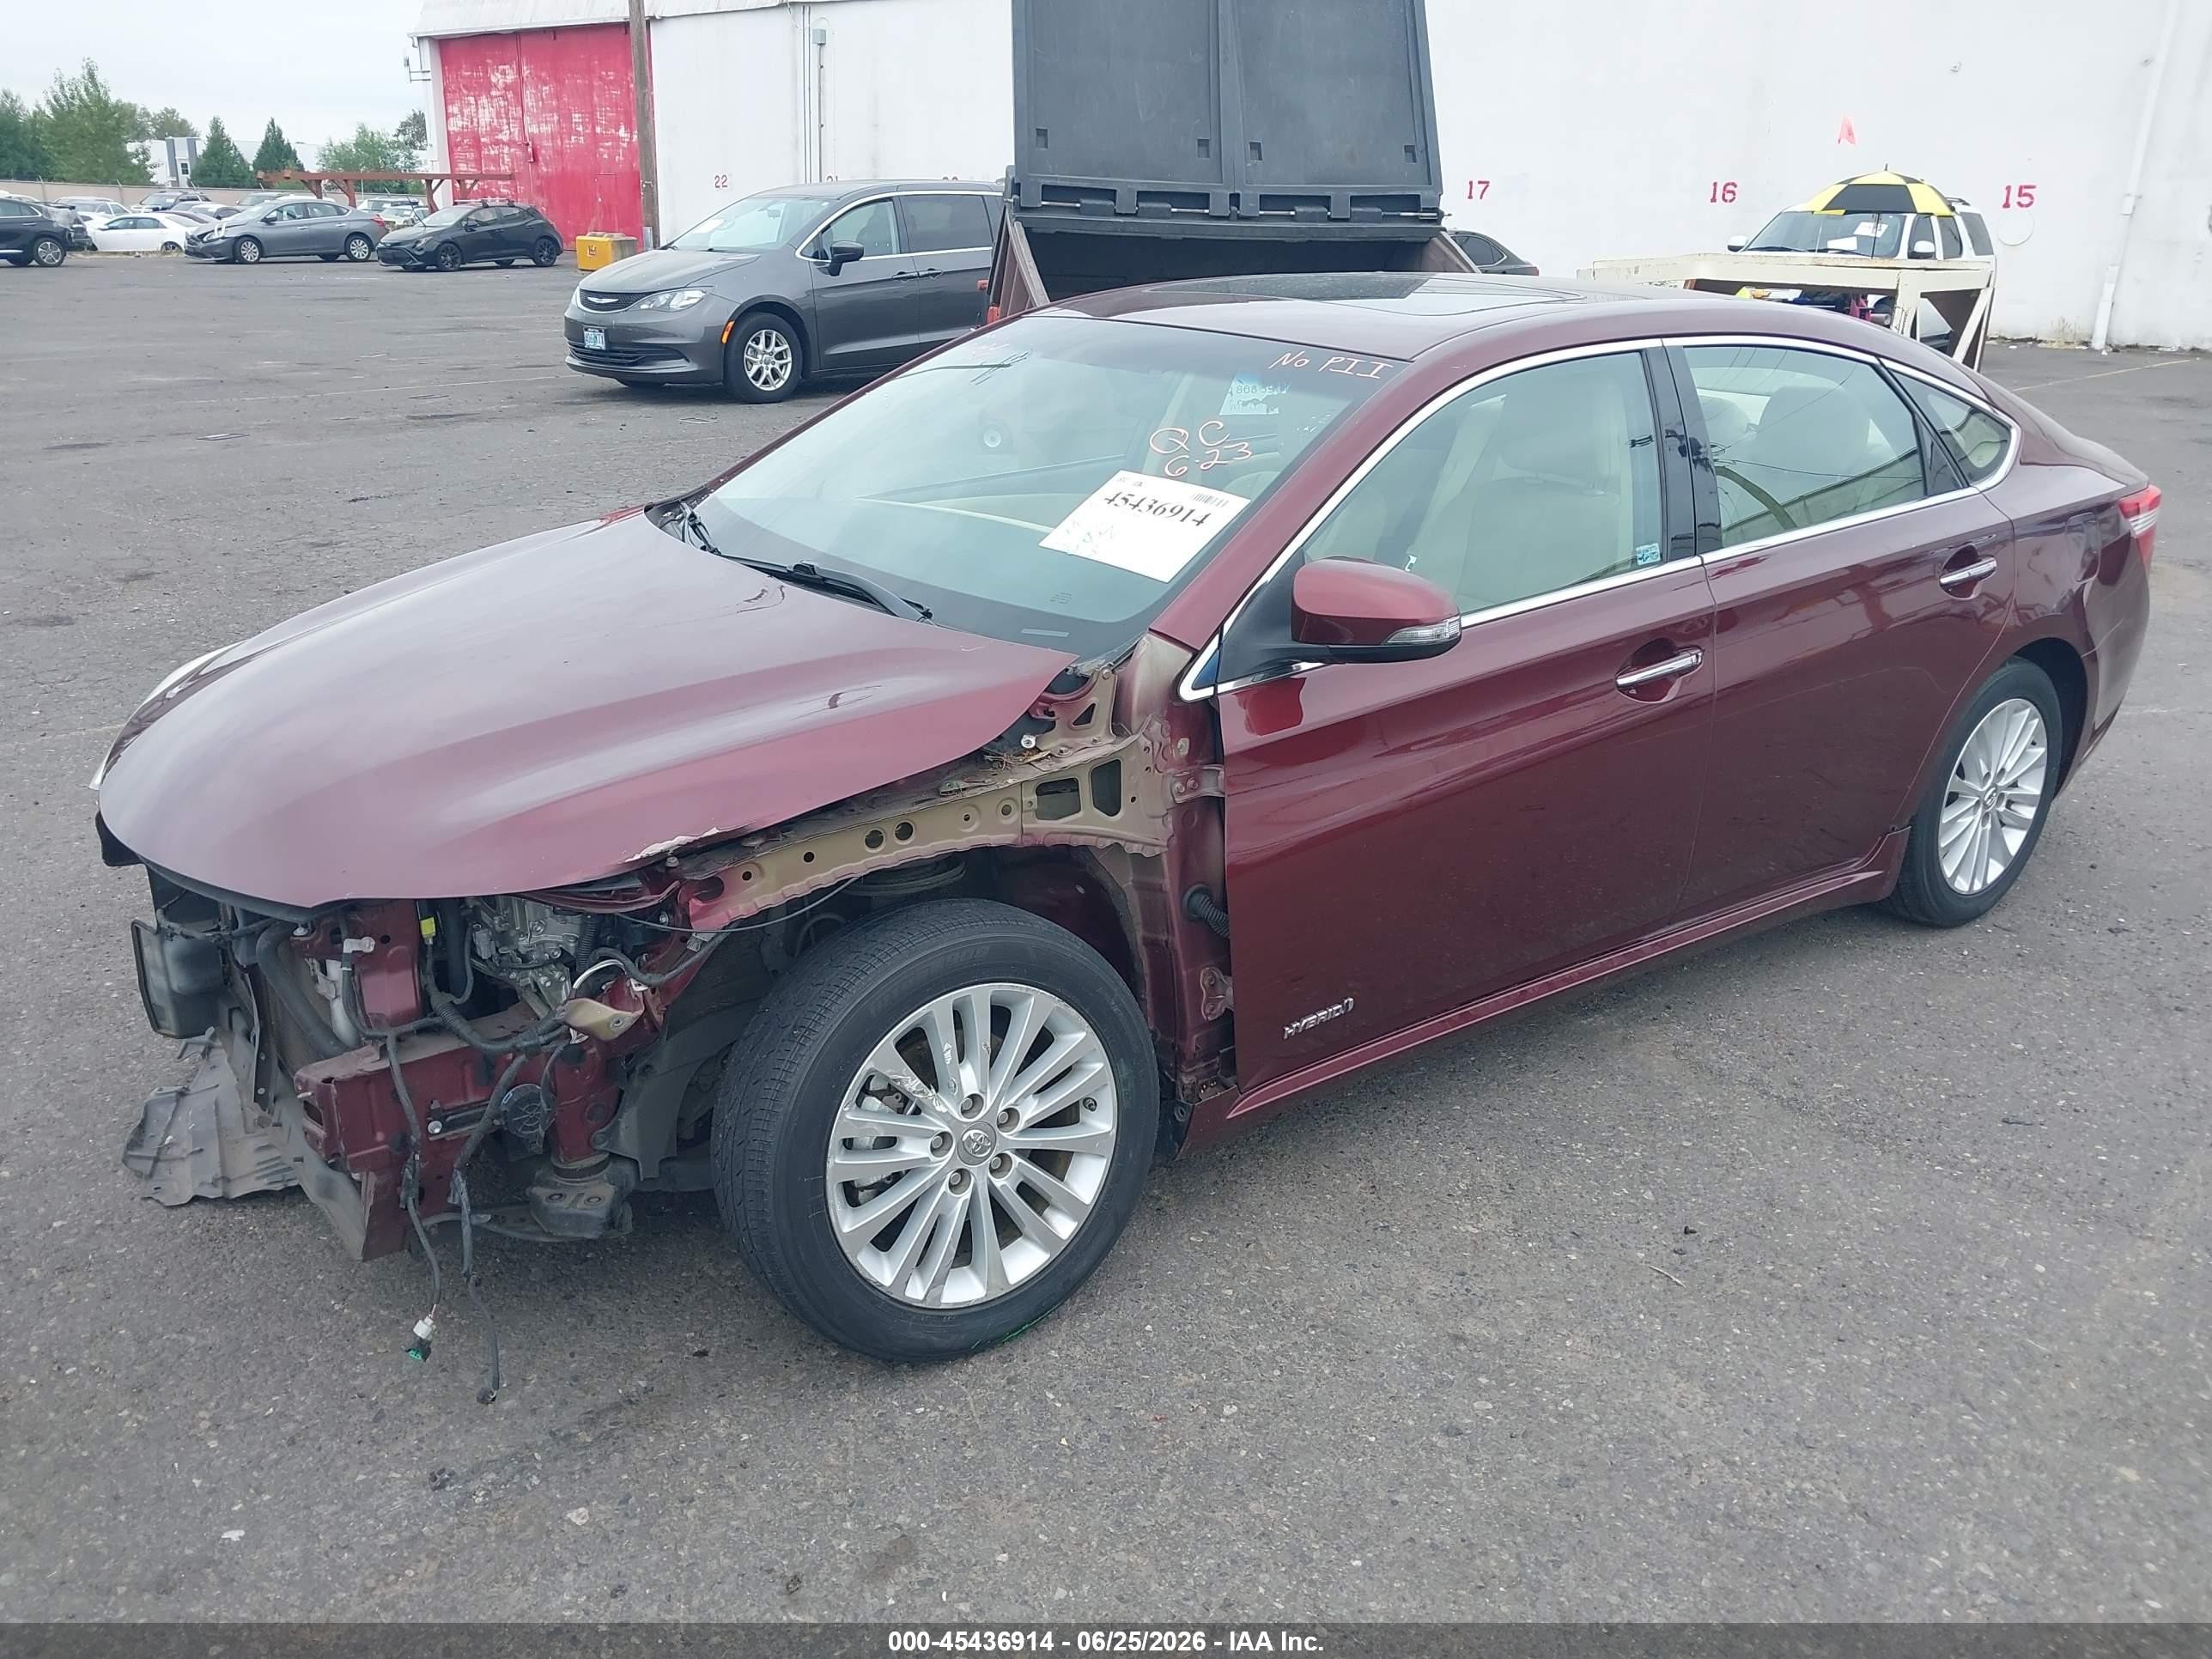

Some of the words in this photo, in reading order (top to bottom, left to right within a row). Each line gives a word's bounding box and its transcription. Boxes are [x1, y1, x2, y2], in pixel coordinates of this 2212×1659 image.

[714, 174, 728, 188] 22
[1468, 180, 1490, 199] 17
[1711, 181, 1738, 203] 16
[2002, 185, 2037, 208] 15
[1268, 350, 1310, 369] No
[1319, 356, 1395, 379] PII
[1103, 490, 1212, 527] 45436914
[1283, 997, 1354, 1040] HYBRID
